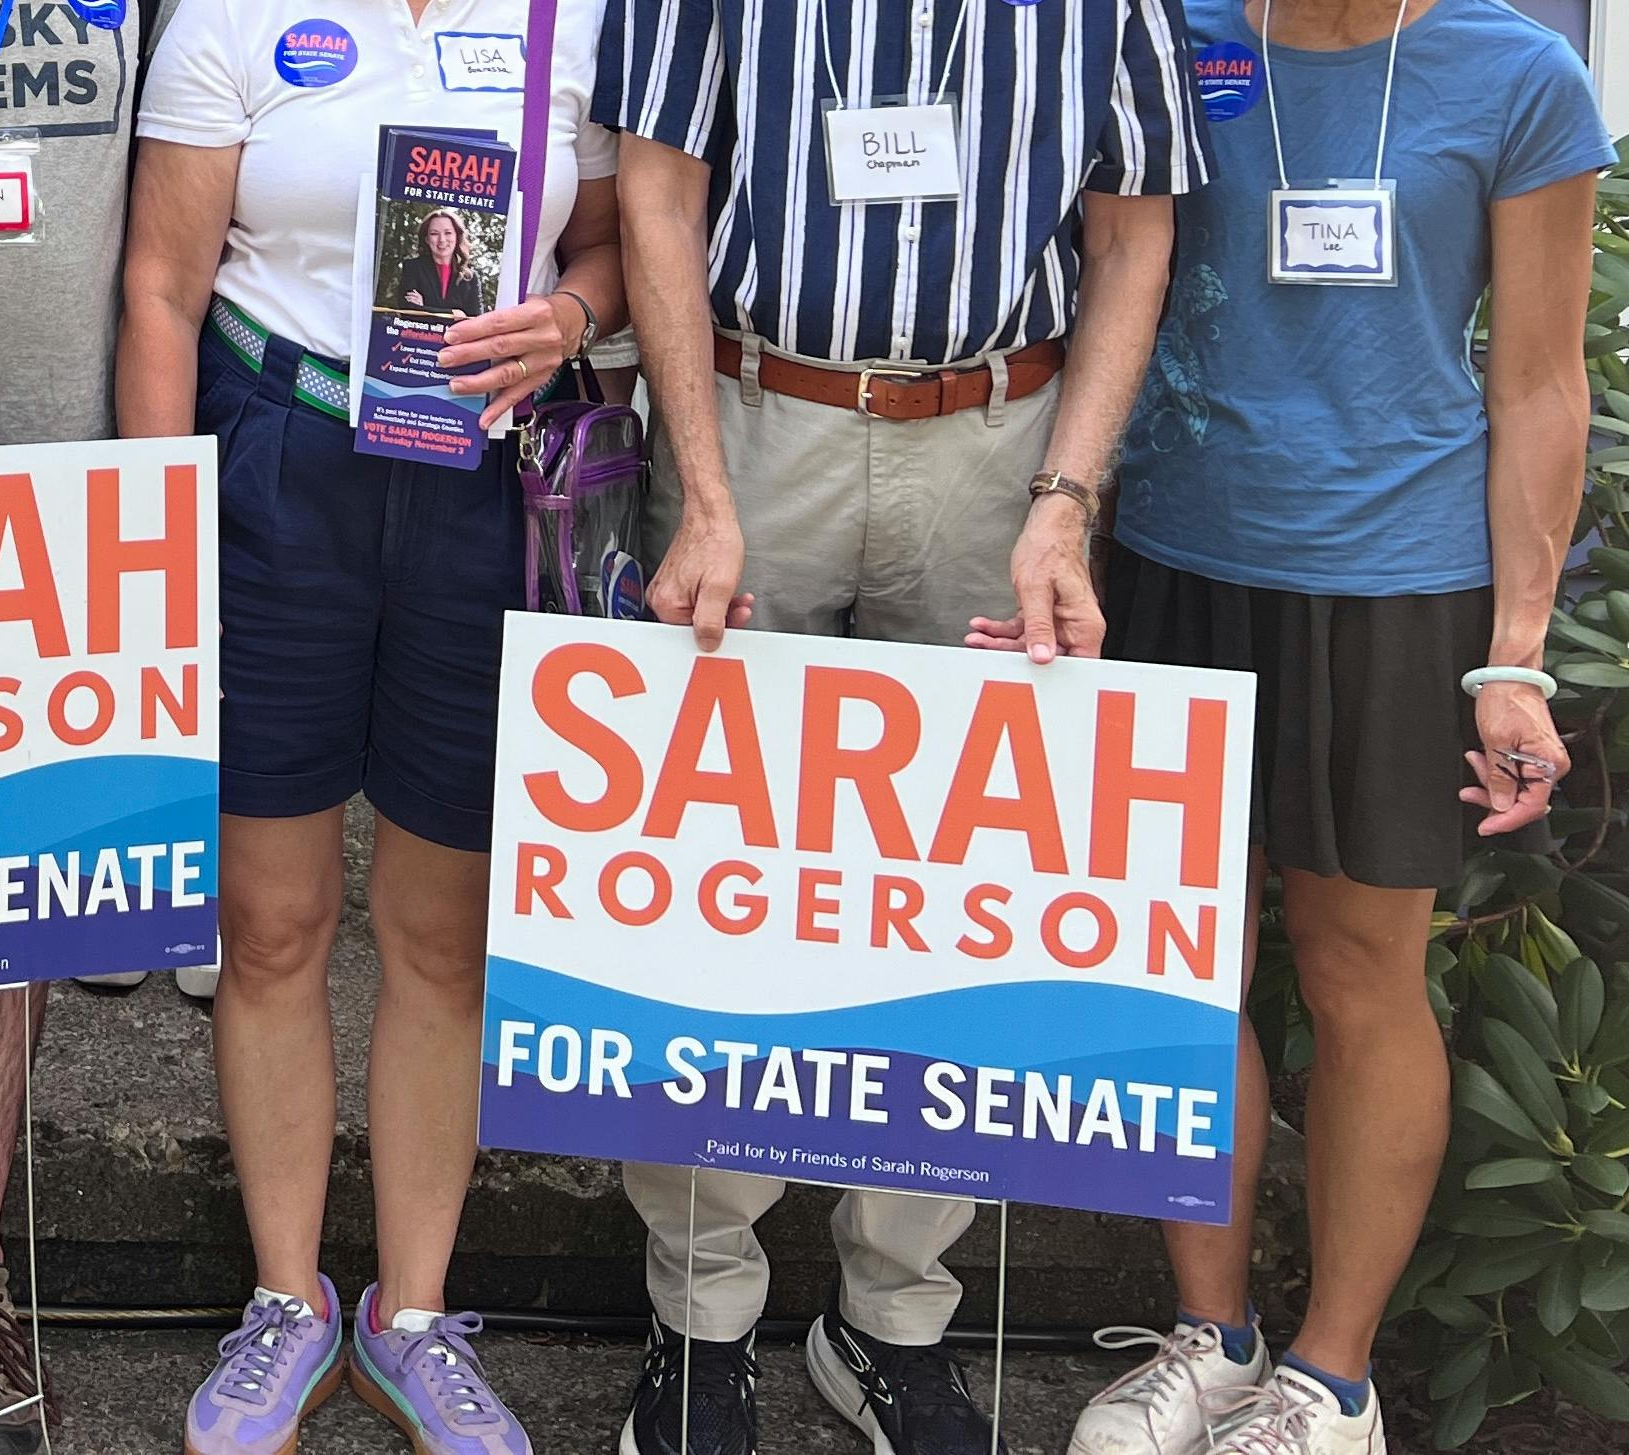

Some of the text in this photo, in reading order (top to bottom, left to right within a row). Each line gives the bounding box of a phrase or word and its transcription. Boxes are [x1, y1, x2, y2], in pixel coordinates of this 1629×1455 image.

[286, 33, 348, 51] SARAH
[460, 48, 506, 64] LISA
[1194, 59, 1253, 76] SARAH
[862, 131, 926, 156] BILL
[408, 146, 501, 184] SARAH
[406, 172, 497, 196] ROGERSON
[404, 186, 495, 208] FOR STATE SENATE
[1302, 222, 1359, 240] TINA
[394, 317, 429, 330] Rogerson
[364, 422, 471, 447] VOTE SARAH ROGERSON
[415, 440, 456, 454] November
[522, 642, 1227, 889] SARAH
[515, 841, 1217, 981] ROGERSON
[497, 1019, 1218, 1160] FOR STATE SENATE
[707, 1139, 990, 1182] Paid for by Friends of Sarah Rogerson
